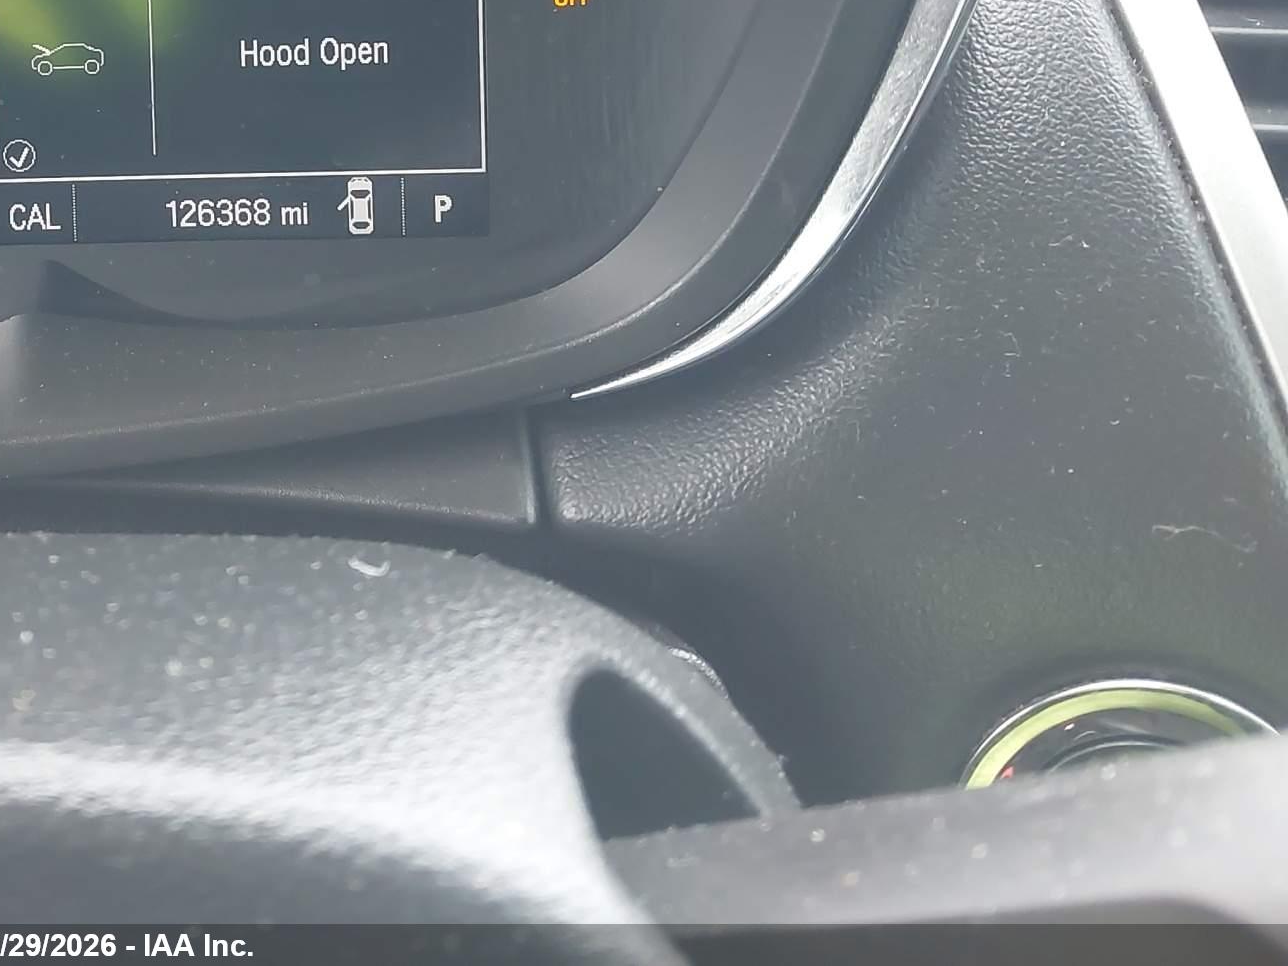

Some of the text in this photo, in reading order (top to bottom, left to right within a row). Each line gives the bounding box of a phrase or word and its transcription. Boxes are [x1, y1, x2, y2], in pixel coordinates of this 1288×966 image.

[239, 38, 389, 71] Hood Open
[9, 204, 60, 230] CAL
[165, 199, 309, 228] 126368 mi
[434, 195, 452, 222] P
